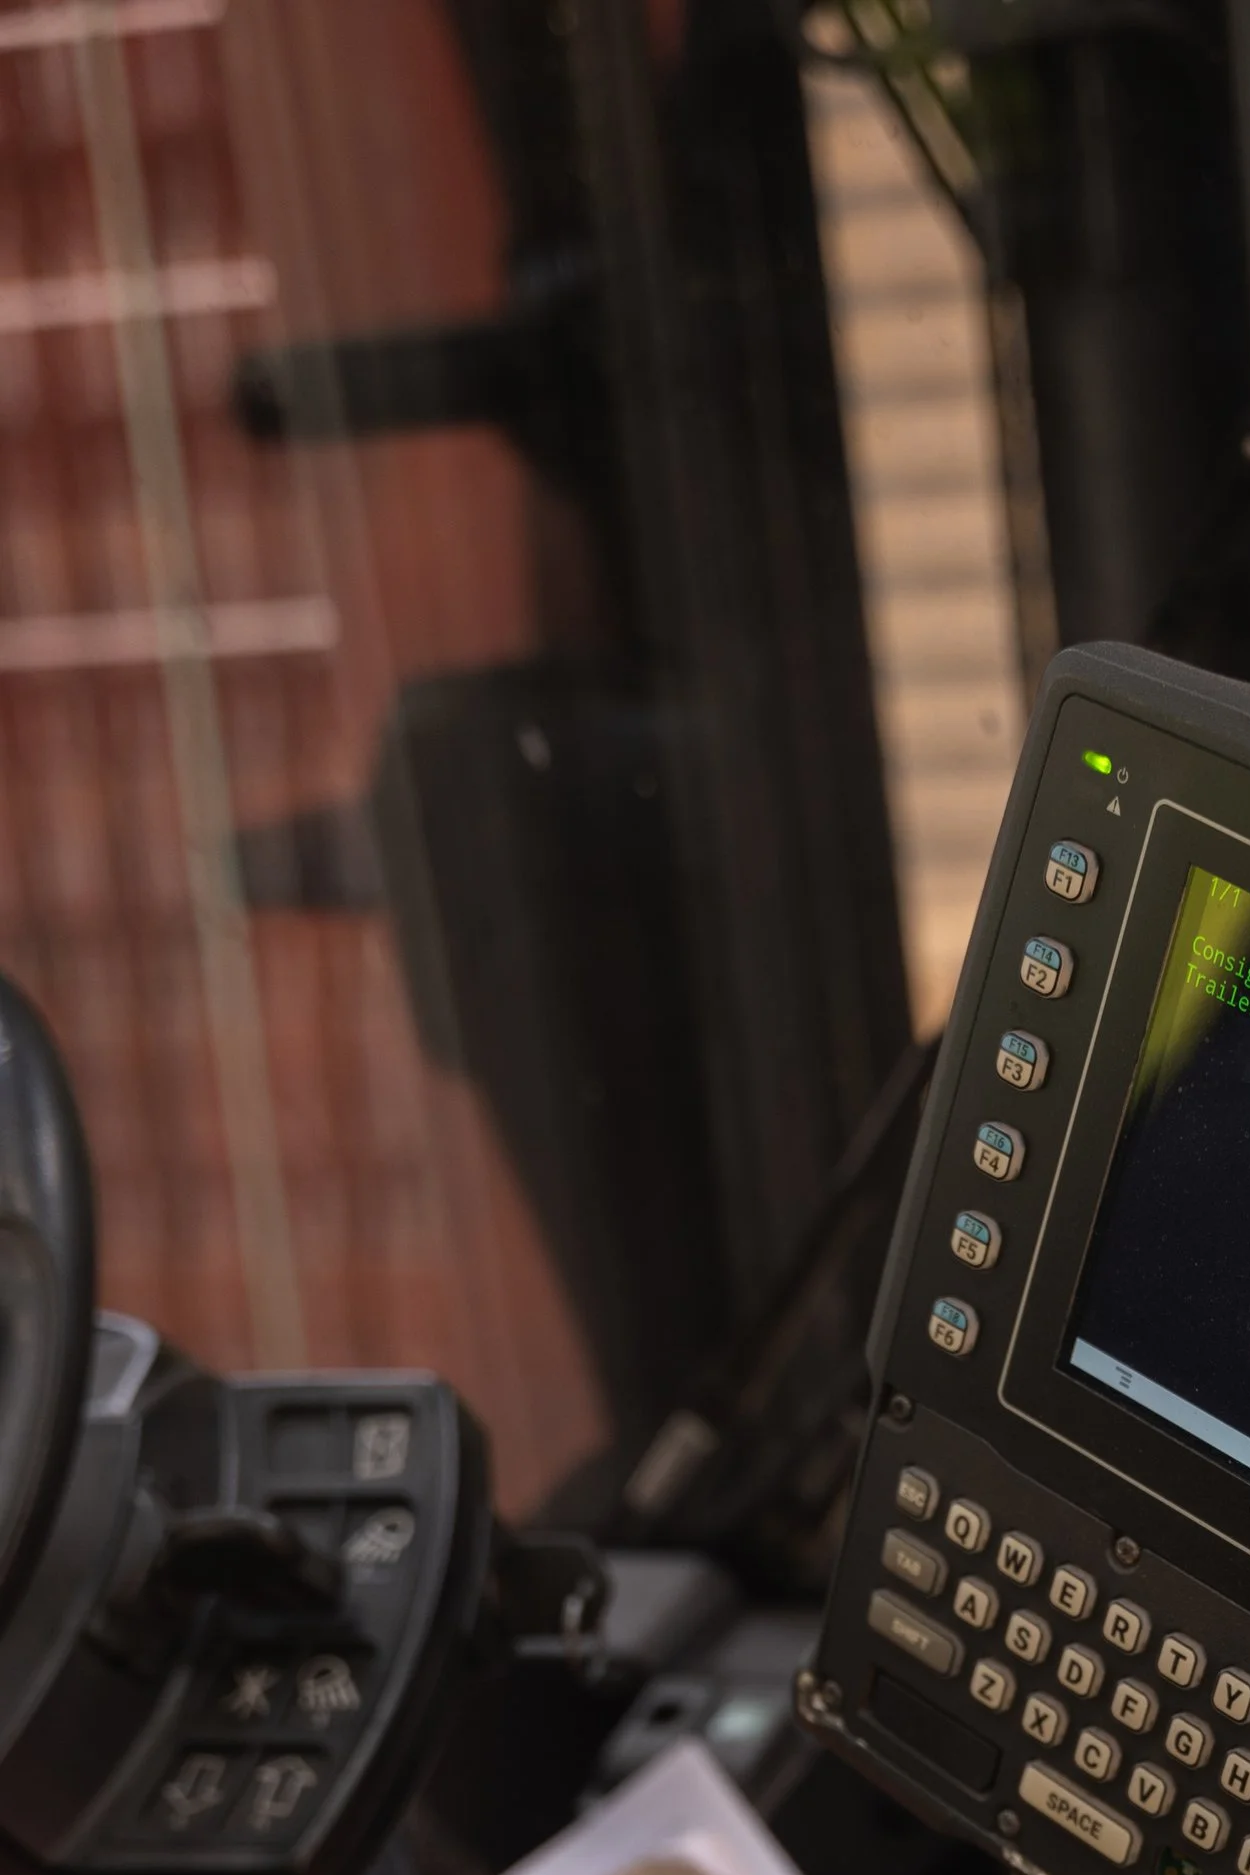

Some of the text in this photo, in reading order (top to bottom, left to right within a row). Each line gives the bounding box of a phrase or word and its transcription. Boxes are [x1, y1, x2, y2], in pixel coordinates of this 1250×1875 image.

[1059, 846, 1080, 868] F13
[1052, 869, 1073, 893] F1
[1210, 877, 1241, 908] 1/1
[1033, 944, 1053, 964] F14
[1026, 964, 1046, 989] F2
[1009, 1040, 1028, 1058] F15
[1002, 1059, 1024, 1083] F3
[985, 1130, 1005, 1149] F16
[978, 1149, 999, 1173] F4
[963, 1218, 982, 1237] F17
[956, 1238, 977, 1260] F5
[934, 1323, 954, 1346] F6
[953, 1516, 970, 1544] Q
[1004, 1546, 1026, 1575] W
[1059, 1582, 1077, 1608] E
[1111, 1615, 1129, 1643] R
[1170, 1648, 1187, 1676] T
[1225, 1683, 1243, 1711] Y
[960, 1594, 977, 1620] A
[1013, 1627, 1031, 1651] S
[1066, 1660, 1083, 1684] D
[1119, 1696, 1137, 1719] F
[1174, 1730, 1192, 1756] G
[1228, 1764, 1250, 1793] H
[978, 1675, 997, 1700] Z
[1030, 1709, 1048, 1735] X
[1083, 1744, 1101, 1769] C
[1138, 1777, 1157, 1802] V
[1190, 1813, 1209, 1841] B
[1046, 1792, 1103, 1841] SPACE
